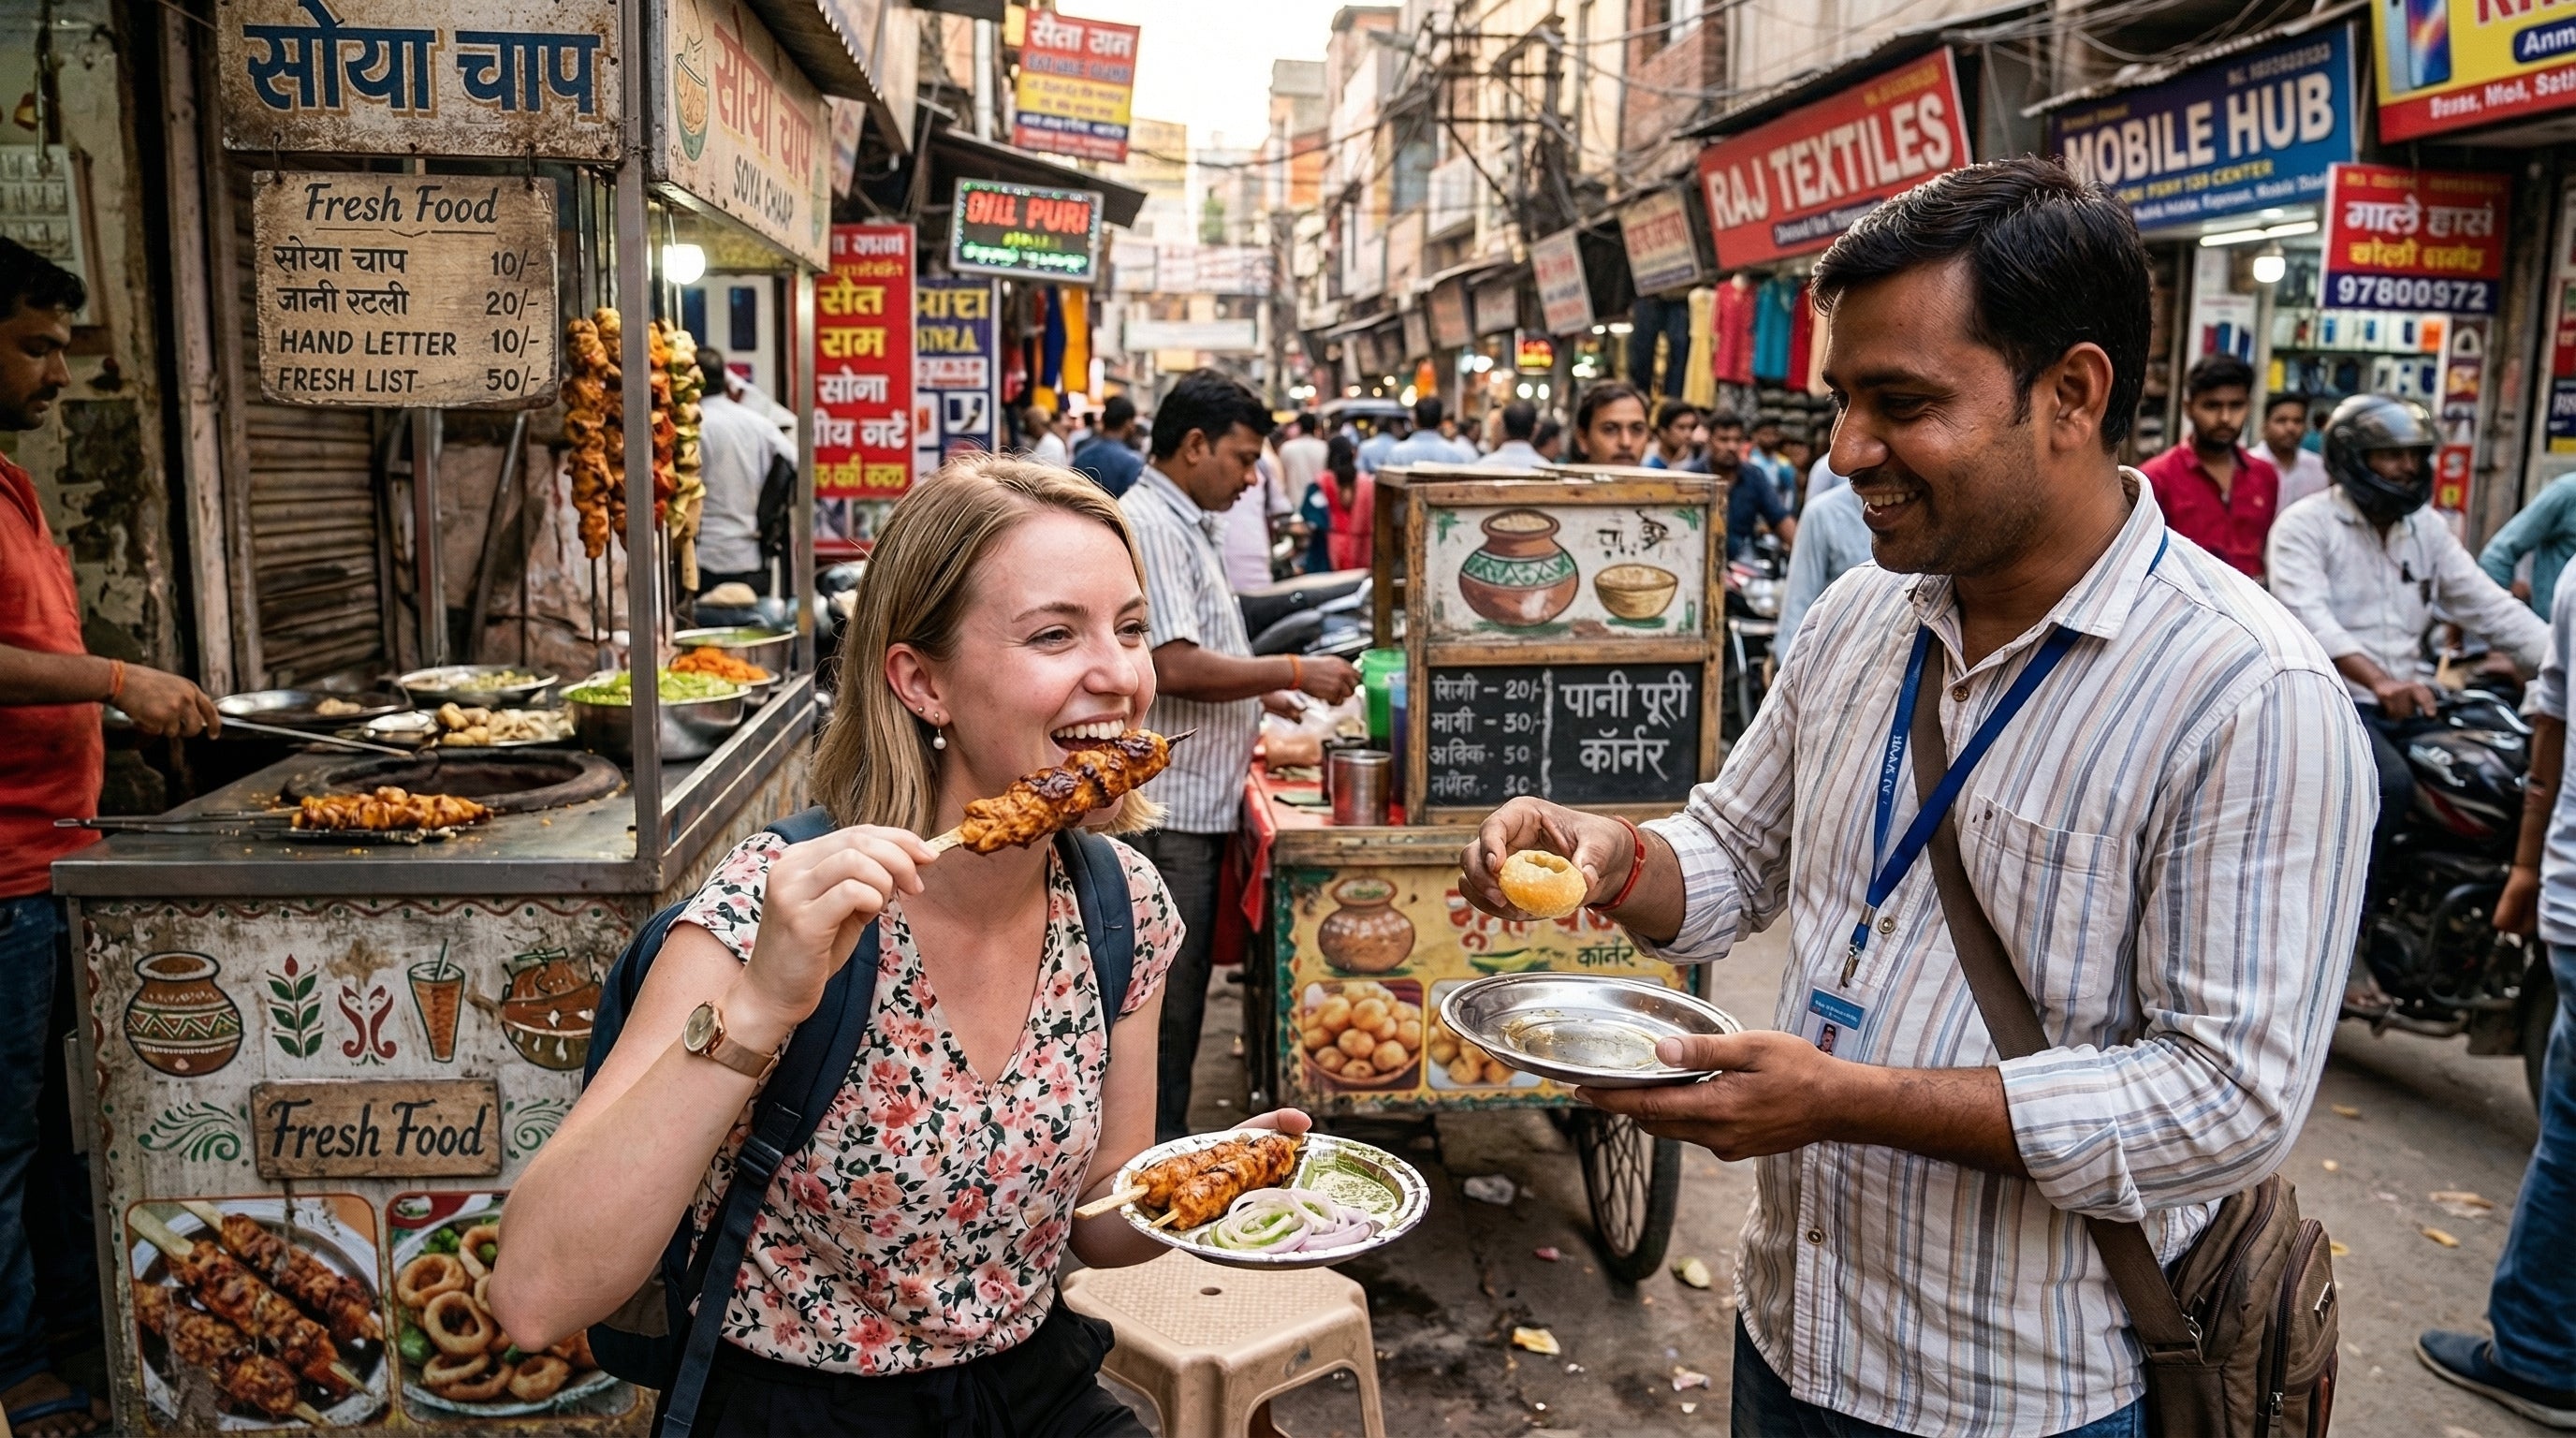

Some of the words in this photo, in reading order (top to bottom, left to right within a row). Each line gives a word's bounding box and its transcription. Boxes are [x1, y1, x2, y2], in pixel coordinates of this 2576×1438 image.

[242, 0, 437, 111] सोया
[455, 29, 602, 115] चाप
[779, 94, 812, 187] चाप
[2064, 100, 2217, 187] MOBILE
[2225, 71, 2335, 159] HUB
[733, 154, 761, 213] SOYA
[1706, 156, 1769, 230] RAJ
[1768, 92, 1953, 213] TEXTILES
[304, 183, 402, 222] Fresh
[416, 184, 499, 224] Food
[1026, 197, 1090, 234] PURI
[272, 235, 343, 272] सोया
[350, 248, 408, 273] चाप
[490, 249, 539, 281] 10/-
[276, 279, 340, 314] जानी
[486, 288, 538, 321] 20/-
[2337, 274, 2489, 311] 97800972
[281, 329, 354, 355] HAND
[365, 330, 457, 356] LETTER
[490, 325, 540, 359] 10/-
[278, 367, 354, 392] FRESH
[365, 369, 419, 393] LIST
[486, 365, 540, 396] 50/-
[1559, 669, 1632, 719] पानी
[1635, 669, 1692, 729] पूरी
[1579, 724, 1671, 783] कॉर्नर
[267, 1098, 381, 1158] Fresh
[392, 1098, 487, 1157] Food
